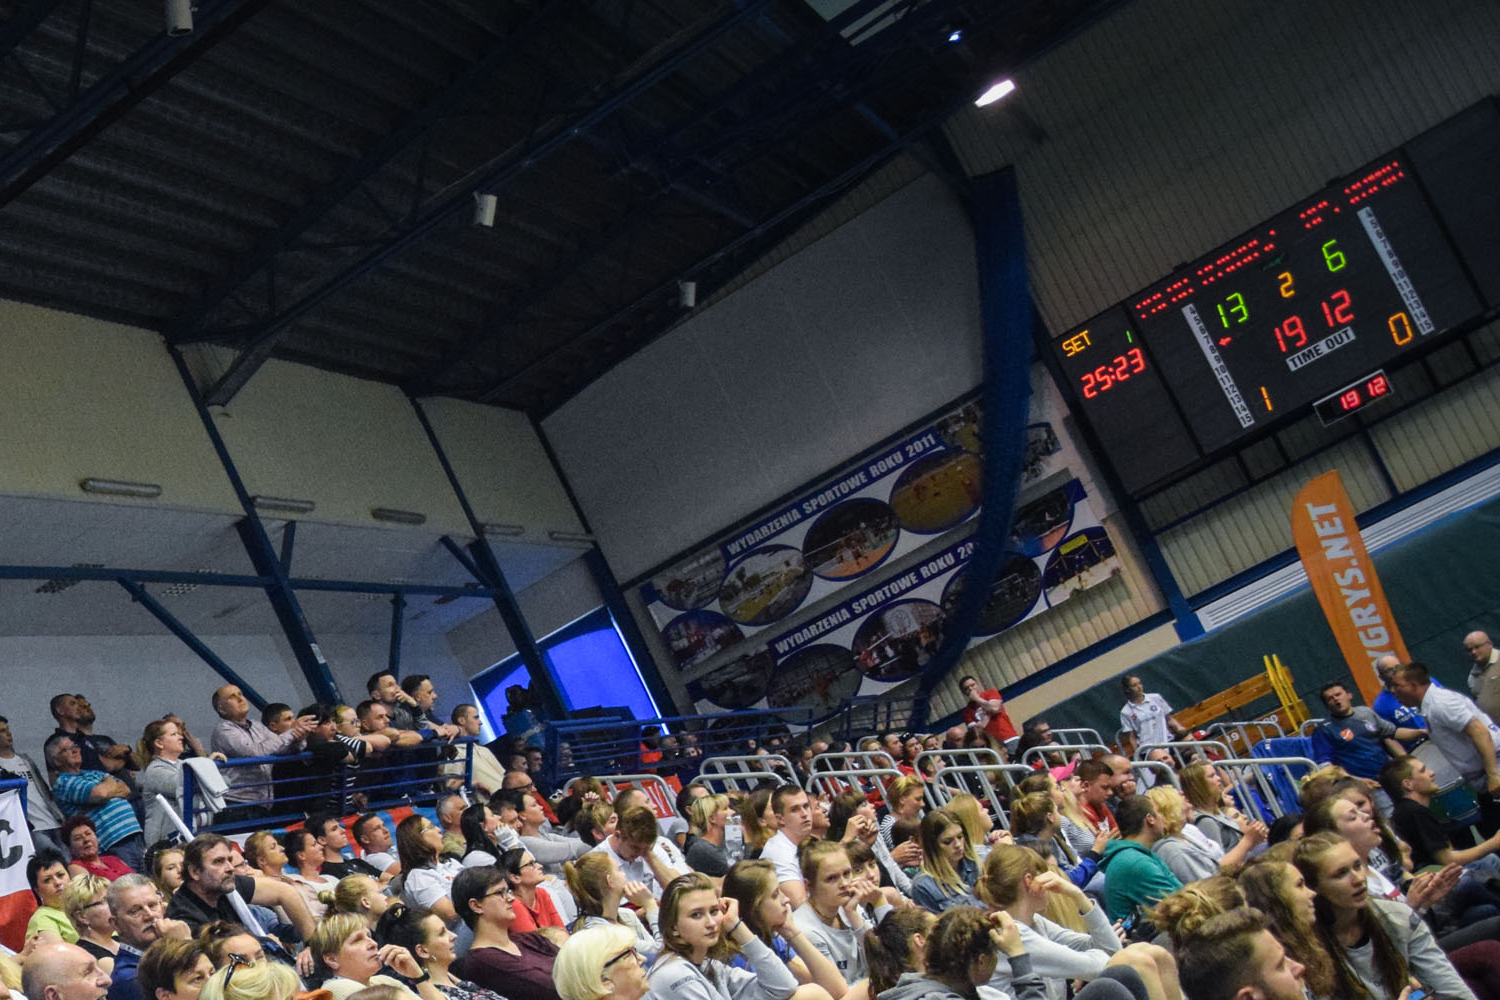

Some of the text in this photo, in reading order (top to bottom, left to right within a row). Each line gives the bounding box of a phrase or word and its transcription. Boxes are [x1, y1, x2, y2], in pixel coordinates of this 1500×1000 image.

[1322, 239, 1347, 273] 6
[1277, 271, 1296, 299] 2
[1217, 291, 1249, 329] 13
[1274, 289, 1355, 353] 19 12
[1387, 311, 1414, 346] 0
[1061, 329, 1133, 357] SET 1
[1289, 328, 1352, 369] TIME OUT
[1260, 385, 1273, 411] 1
[1340, 375, 1387, 411] 19 12
[726, 433, 936, 556] WYDARZENIA SPORTOWE ROKU 2011
[774, 607, 852, 655] WYDARZENIA
[851, 572, 919, 615] SPORTOWE
[919, 552, 956, 579] ROKU
[1304, 501, 1396, 688] YGRYS.NET
